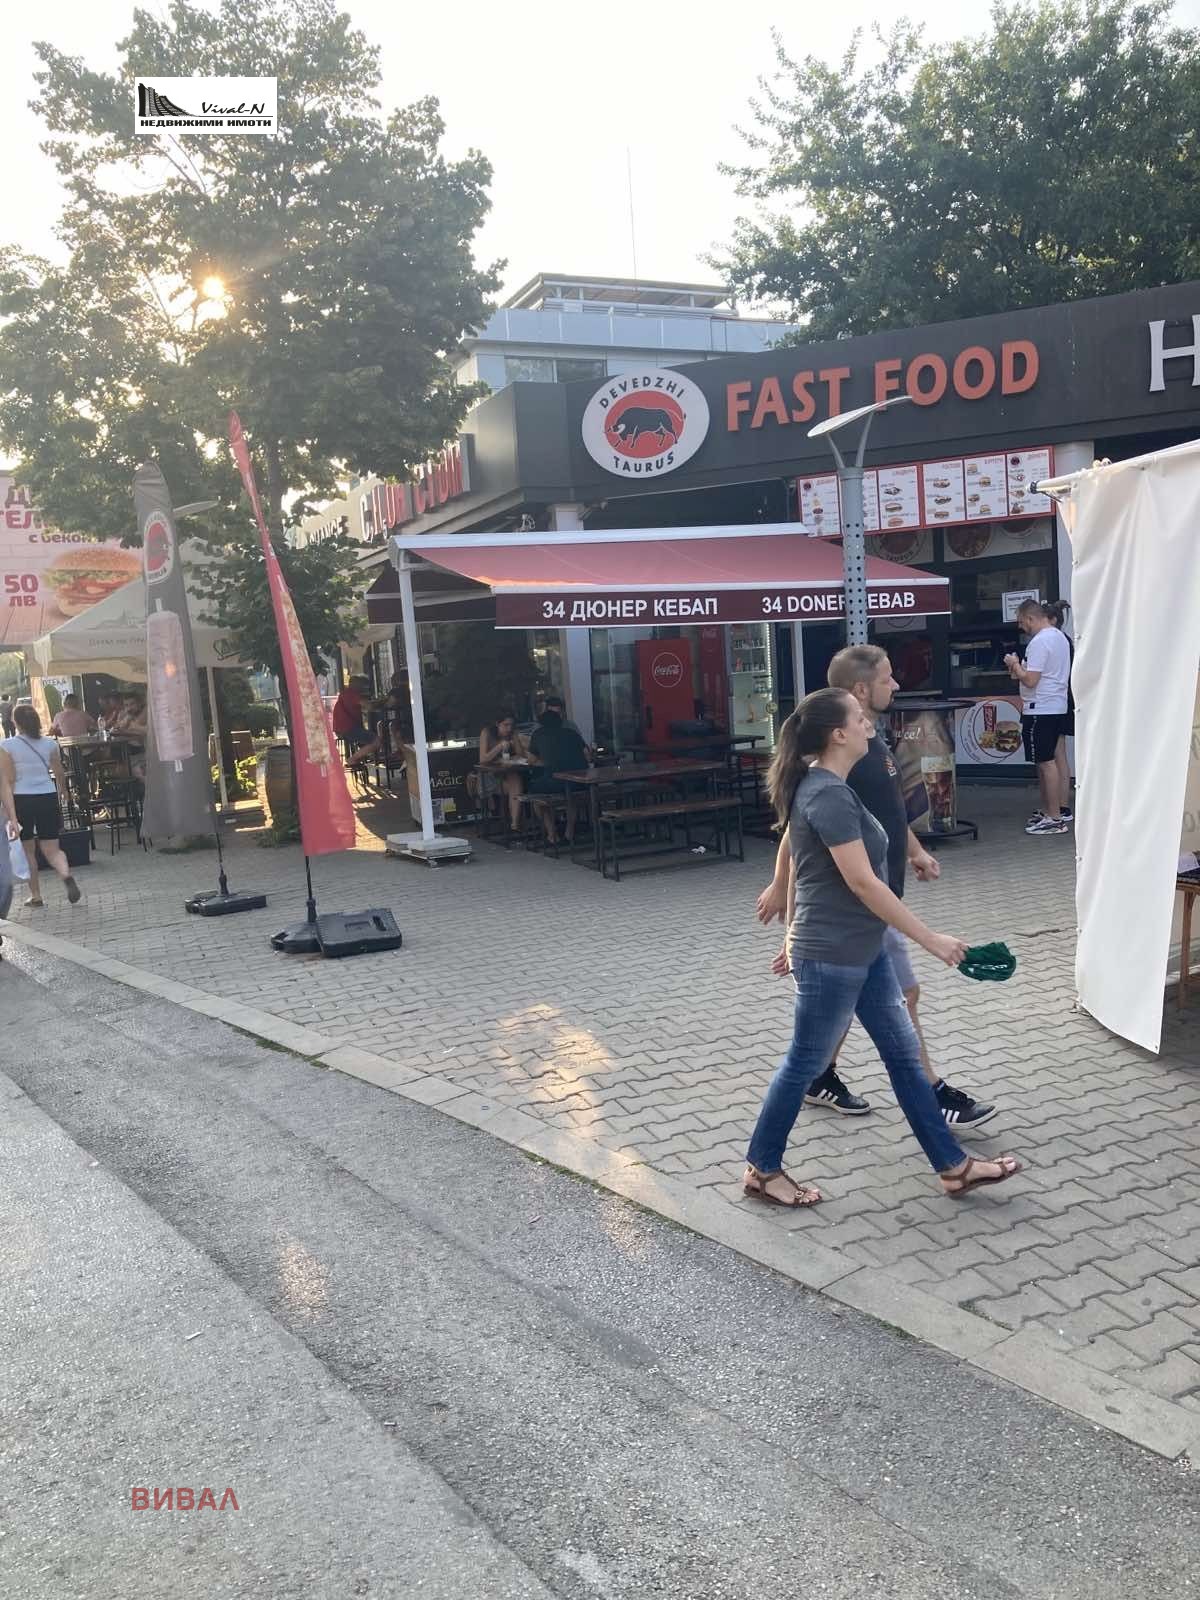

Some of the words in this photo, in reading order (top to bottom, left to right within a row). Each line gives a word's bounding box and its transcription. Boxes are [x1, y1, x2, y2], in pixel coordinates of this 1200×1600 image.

[1148, 314, 1200, 392] H
[599, 376, 685, 409] DEVEDZHI
[727, 367, 850, 431] FAST
[874, 339, 1039, 411] FOOD
[613, 451, 675, 473] TAURUS
[4, 574, 39, 594] 50
[542, 600, 566, 619] 34
[570, 599, 648, 622] ДЮНЕР
[653, 597, 718, 617] КЕБАП
[762, 596, 783, 614] 34
[867, 592, 916, 609] EBAB
